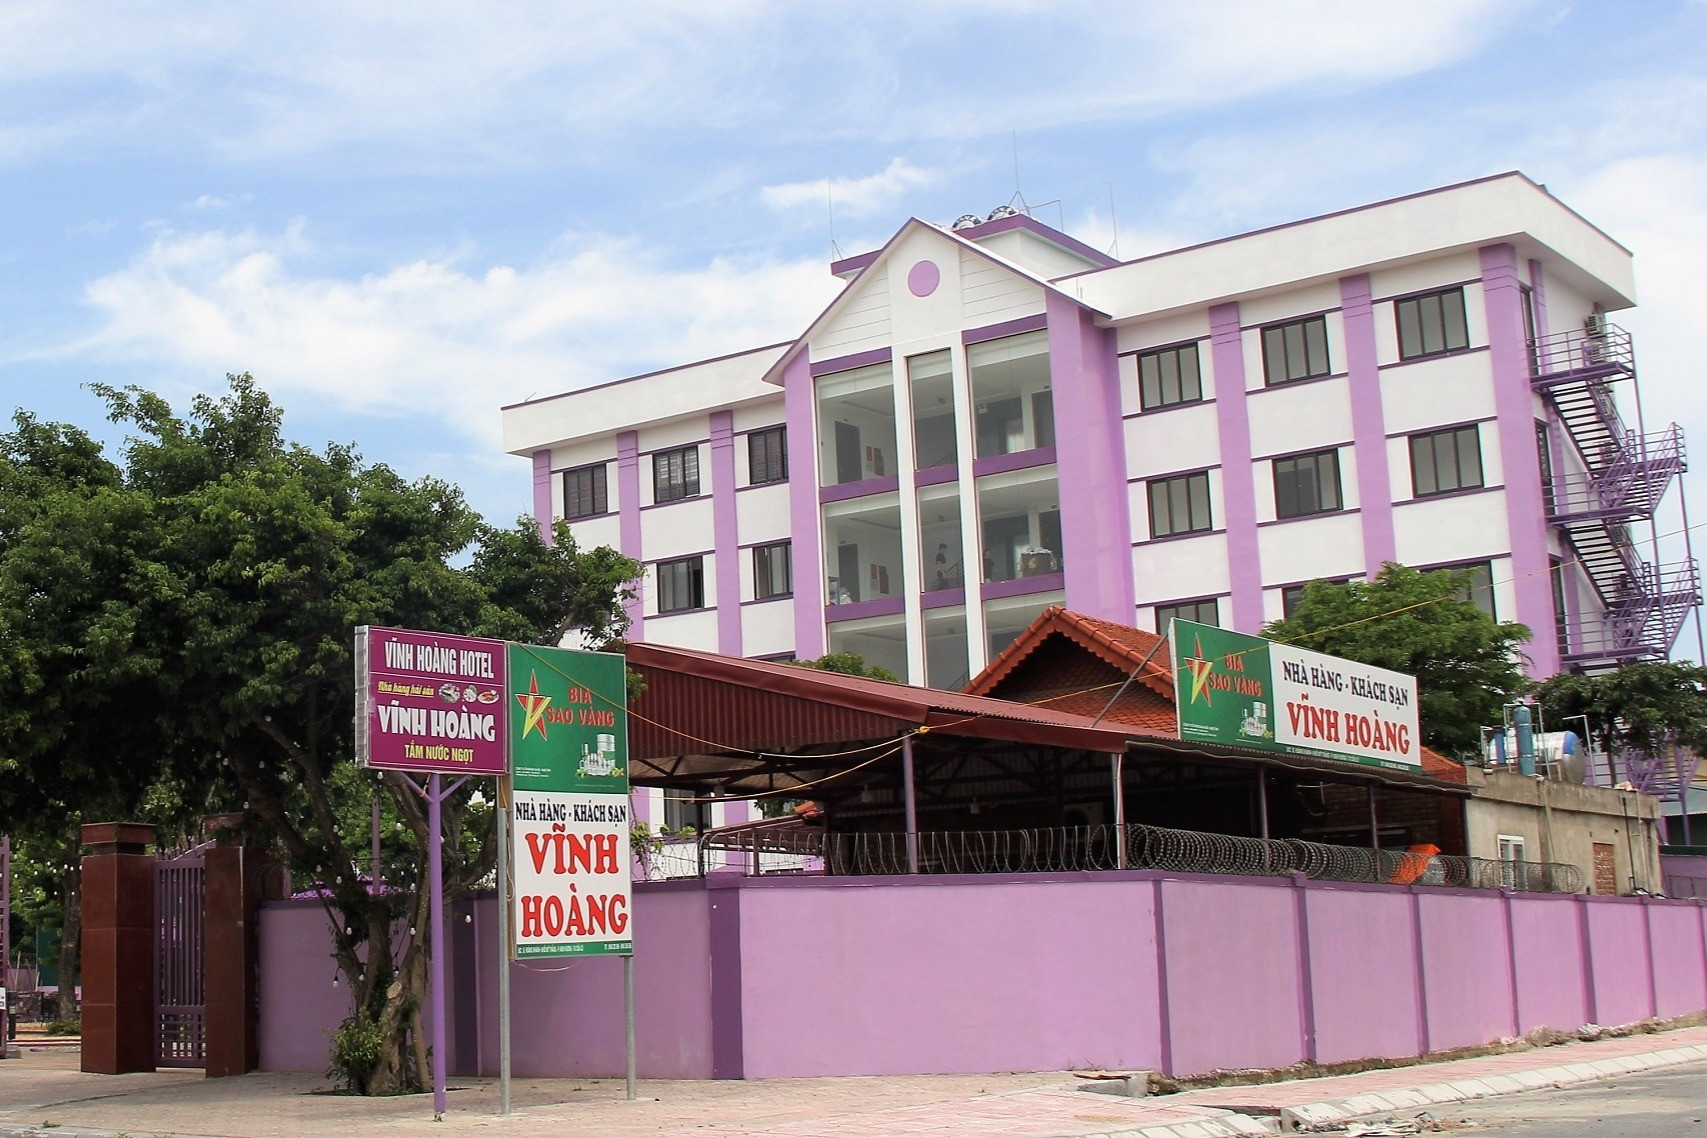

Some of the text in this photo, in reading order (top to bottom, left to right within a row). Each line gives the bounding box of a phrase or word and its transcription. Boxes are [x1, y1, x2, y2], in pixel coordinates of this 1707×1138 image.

[385, 637, 494, 679] VĨNH HOÀNG HOTEL
[1224, 653, 1244, 672] BIA
[569, 687, 592, 704] BIA
[1209, 672, 1262, 697] SAO VÀNG
[1282, 659, 1309, 685] NHÀ
[1311, 663, 1342, 692] HÀNG
[1350, 675, 1387, 702] KHÁCH
[1388, 685, 1408, 710] SẠN
[377, 700, 496, 742] VĨNH HOÀNG
[546, 706, 615, 728] SAO VÀNG
[1287, 693, 1411, 755] VĨNH HOÀNG
[405, 740, 474, 765] TẮM NƯỚC NGỌT
[515, 797, 537, 821] NHÀ
[539, 798, 567, 822] HÀNG
[573, 799, 606, 822] KHÁCH
[608, 804, 627, 828] SẠN
[525, 823, 619, 874] VĨNH
[521, 883, 629, 937] HOÀNG
